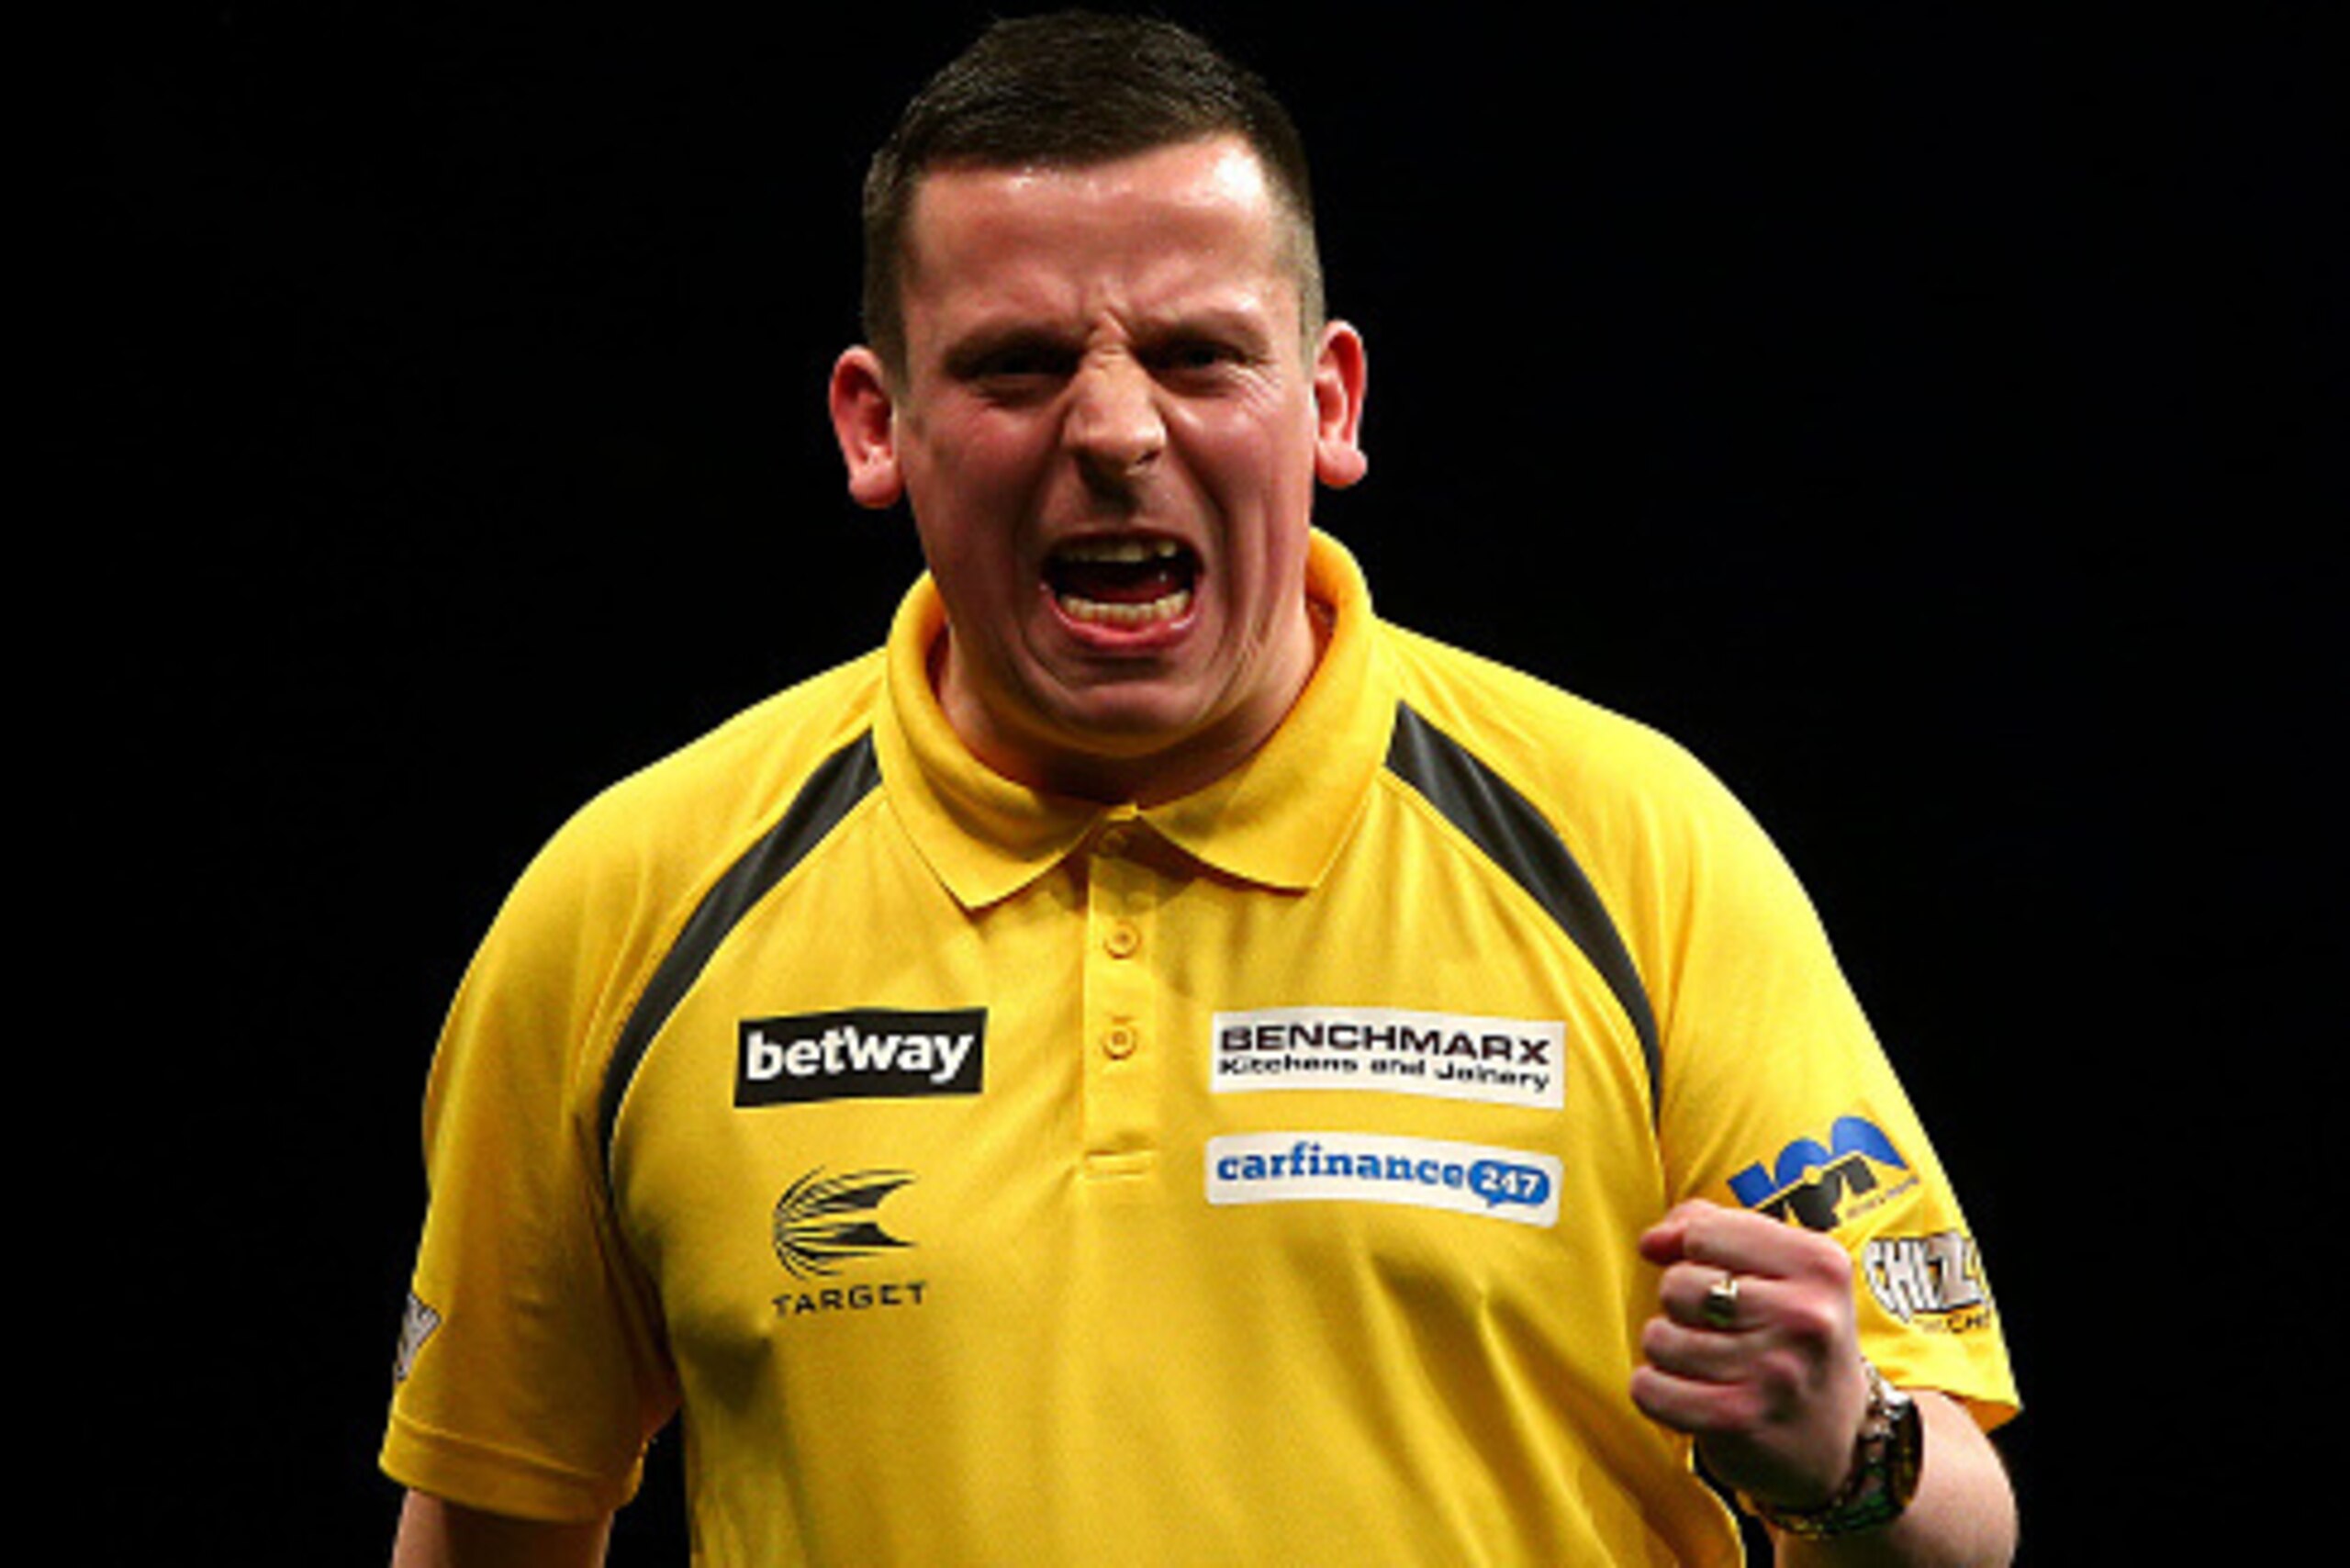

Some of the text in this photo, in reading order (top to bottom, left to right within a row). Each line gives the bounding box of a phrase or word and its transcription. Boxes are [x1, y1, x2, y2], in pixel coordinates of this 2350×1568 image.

[746, 1025, 974, 1084] betway
[1221, 1024, 1550, 1065] BENCHMARX
[1219, 1054, 1550, 1092] Kitchens and Joinery
[772, 1281, 926, 1317] TARGET
